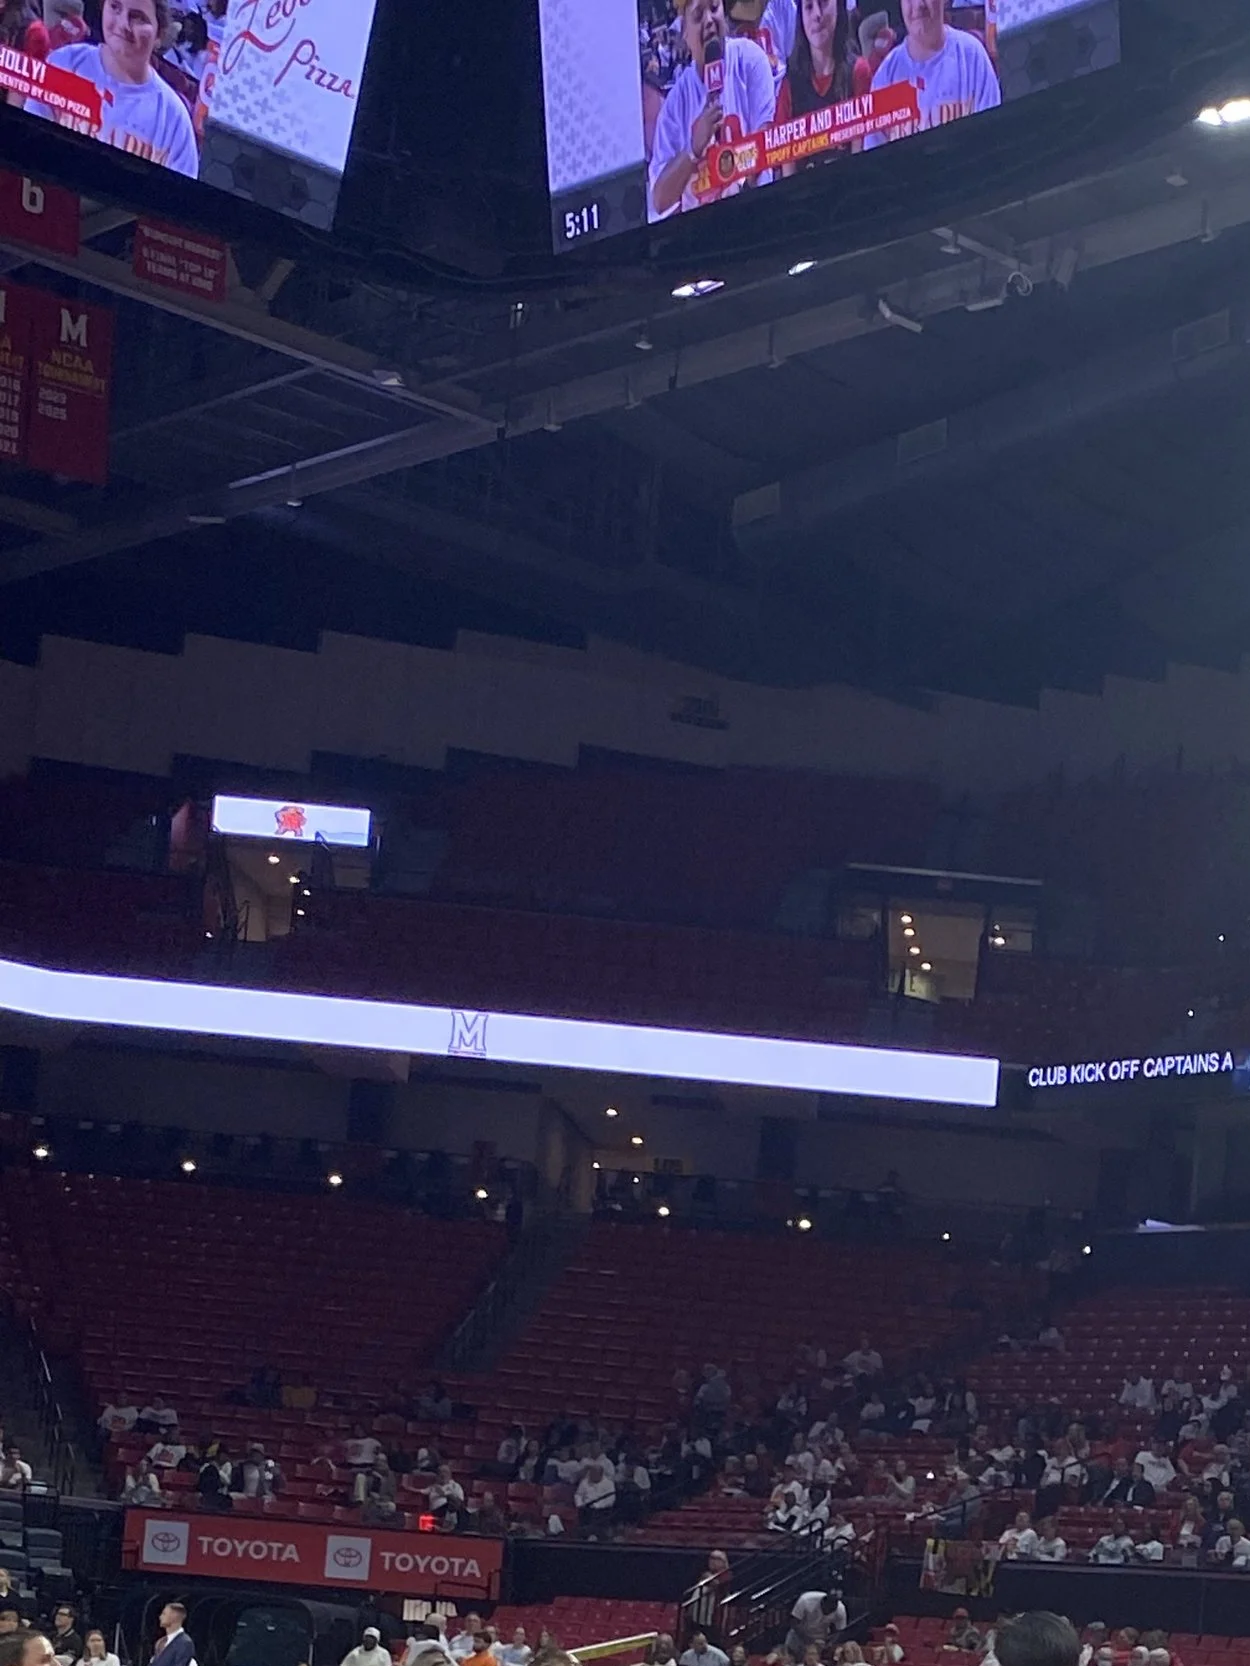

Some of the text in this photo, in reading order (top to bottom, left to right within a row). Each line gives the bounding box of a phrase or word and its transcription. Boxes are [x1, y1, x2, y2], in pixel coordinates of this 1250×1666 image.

[273, 39, 355, 99] Pizza
[31, 84, 43, 99] BY
[44, 89, 66, 108] LEDO
[67, 100, 91, 117] PIZZA
[764, 120, 806, 150] HARPER
[810, 109, 832, 135] AND
[792, 134, 829, 158] CAPTAINS
[830, 123, 865, 144] PRESENTED
[875, 115, 891, 129] LEDO
[893, 107, 911, 122] PIZZA
[565, 204, 600, 239] 5:11
[60, 308, 87, 347] M
[448, 1011, 488, 1050] M
[1028, 1052, 1233, 1087] CLUB KICK OFF CAPTAINS A
[198, 1536, 482, 1579] TOYOTA TOYOTA
